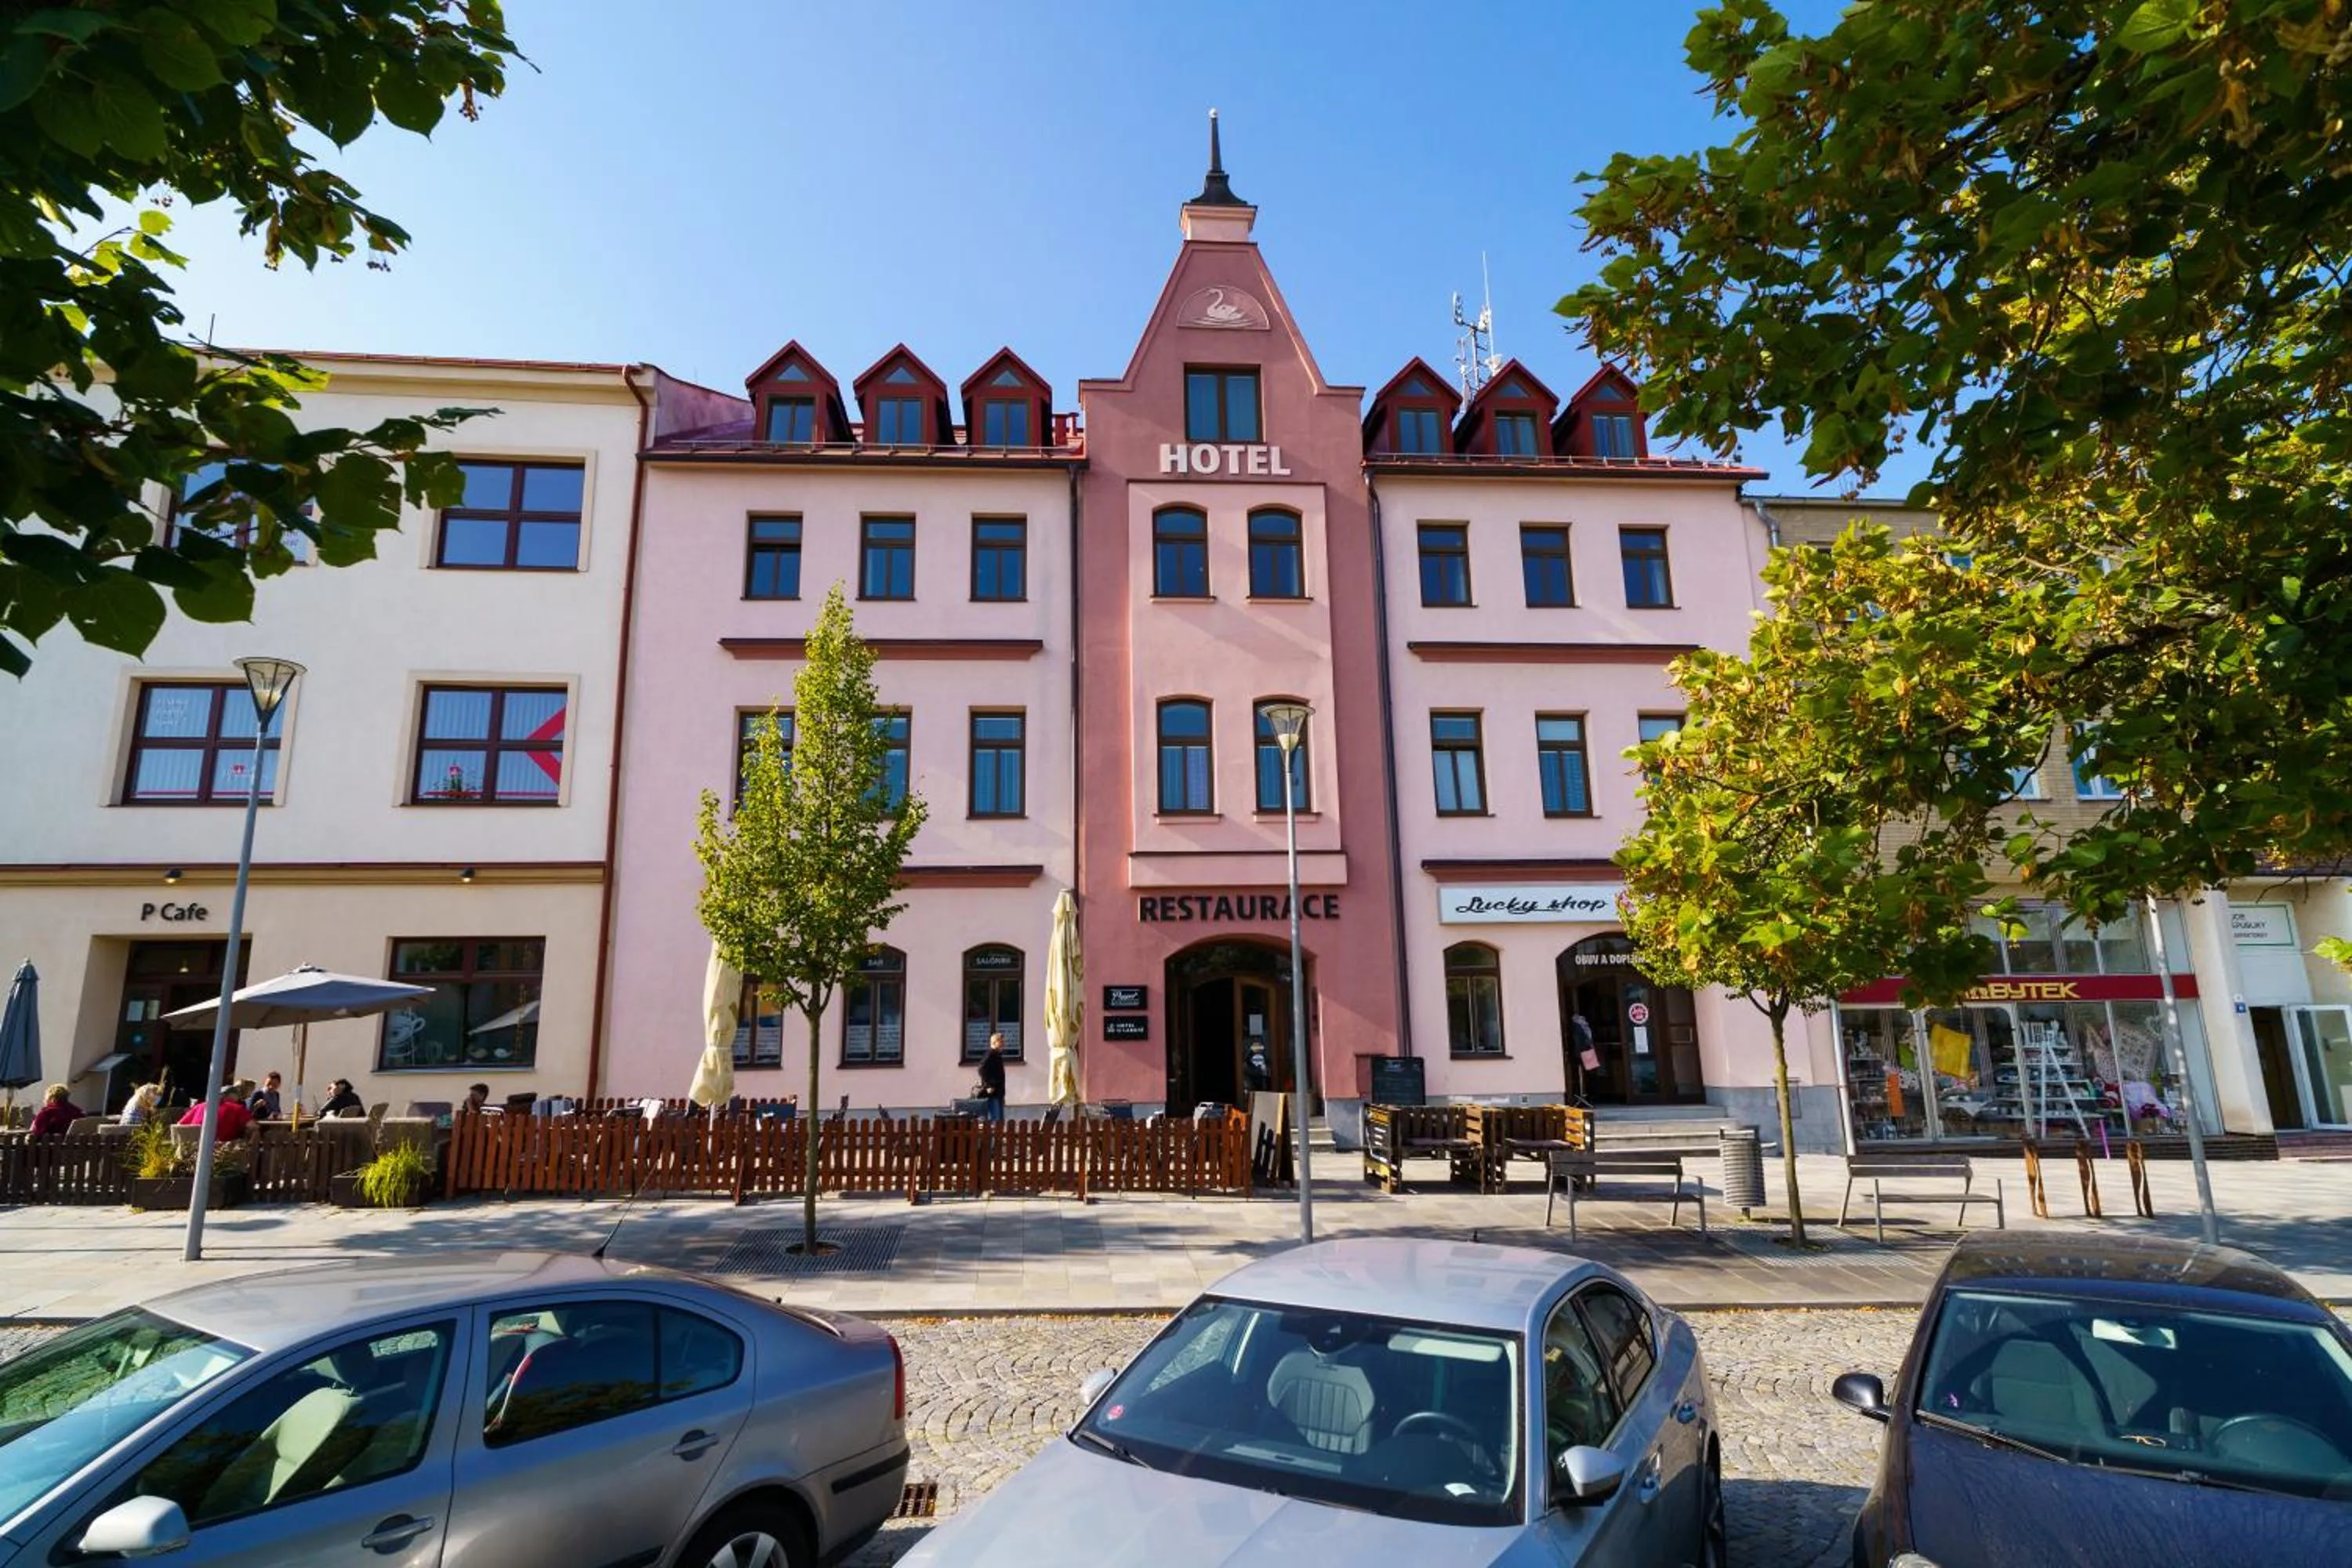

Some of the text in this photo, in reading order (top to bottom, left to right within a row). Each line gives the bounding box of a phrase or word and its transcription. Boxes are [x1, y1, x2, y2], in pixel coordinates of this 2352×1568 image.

[1159, 443, 1291, 475] HOTEL
[141, 902, 209, 921] P Cafe
[1138, 894, 1340, 922] RESTAURACE
[1456, 895, 1607, 915] Lucky shop
